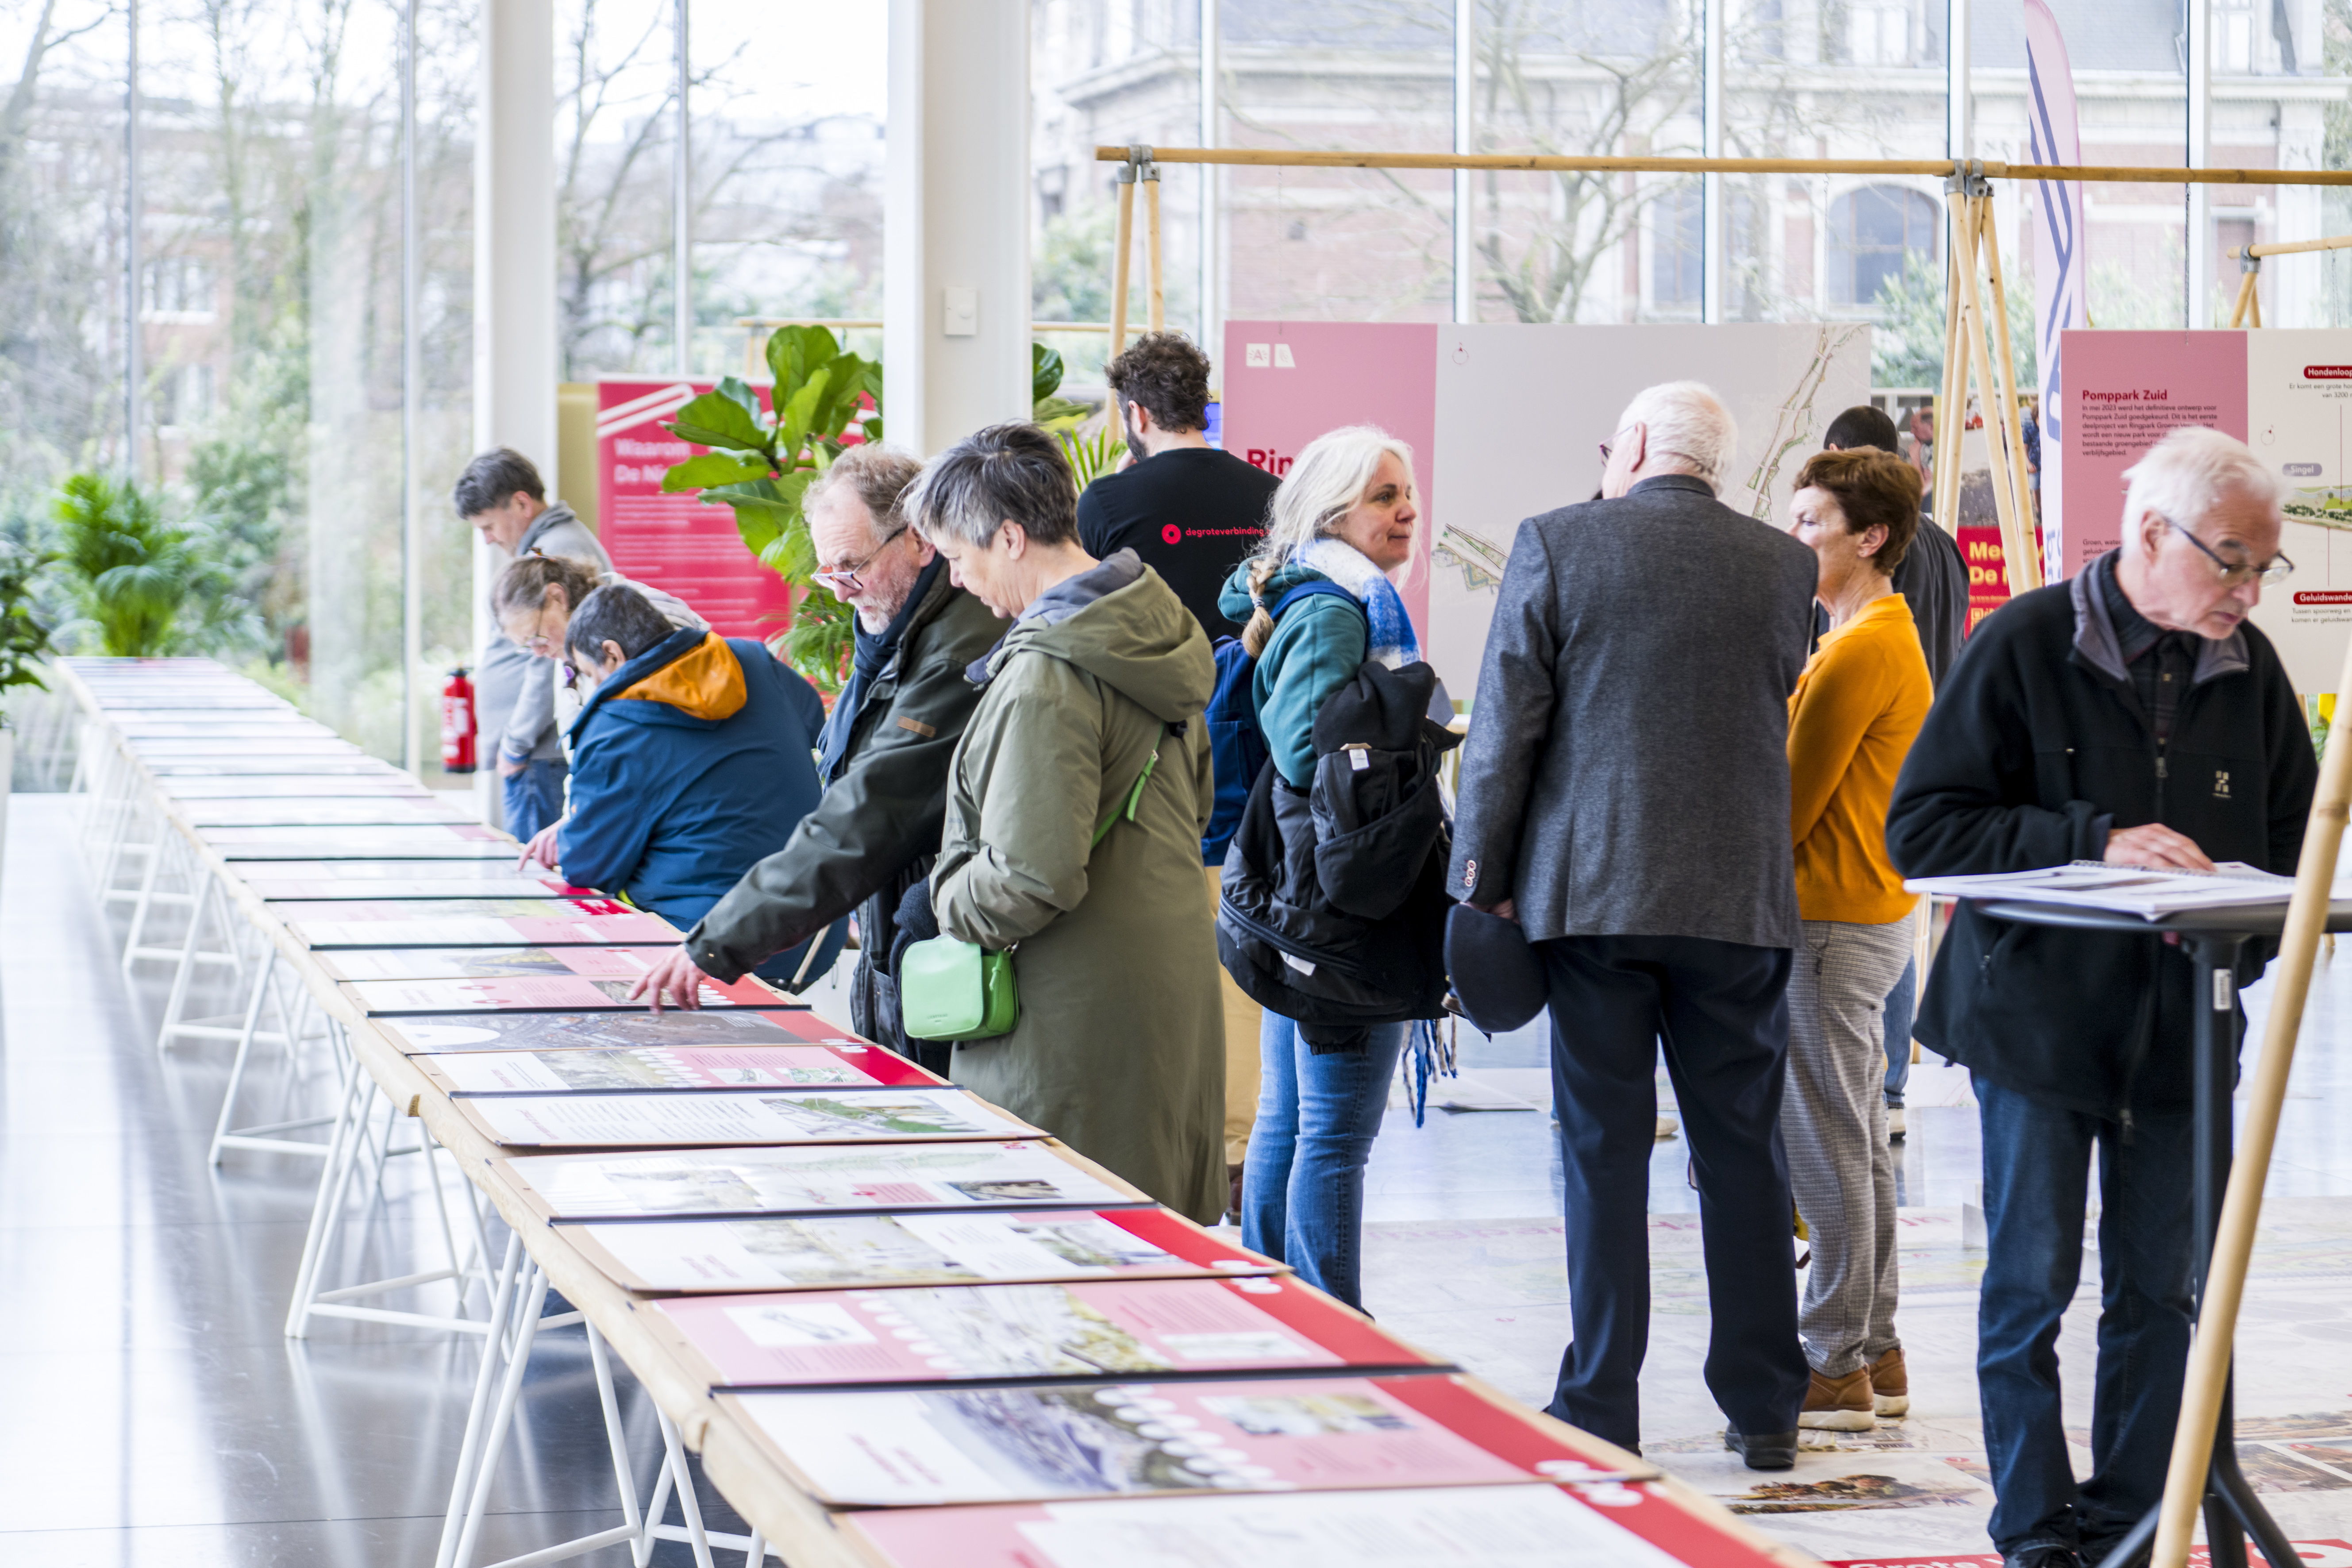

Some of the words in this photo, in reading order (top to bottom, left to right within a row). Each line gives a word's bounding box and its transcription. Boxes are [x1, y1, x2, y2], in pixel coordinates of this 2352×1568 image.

[2083, 389, 2139, 403] Pomppark
[2143, 389, 2167, 400] Zuid
[614, 438, 690, 457] Waarom
[2290, 465, 2314, 474] Singel
[1186, 526, 1273, 537] degroteverbinding.b
[1969, 566, 1998, 586] De
